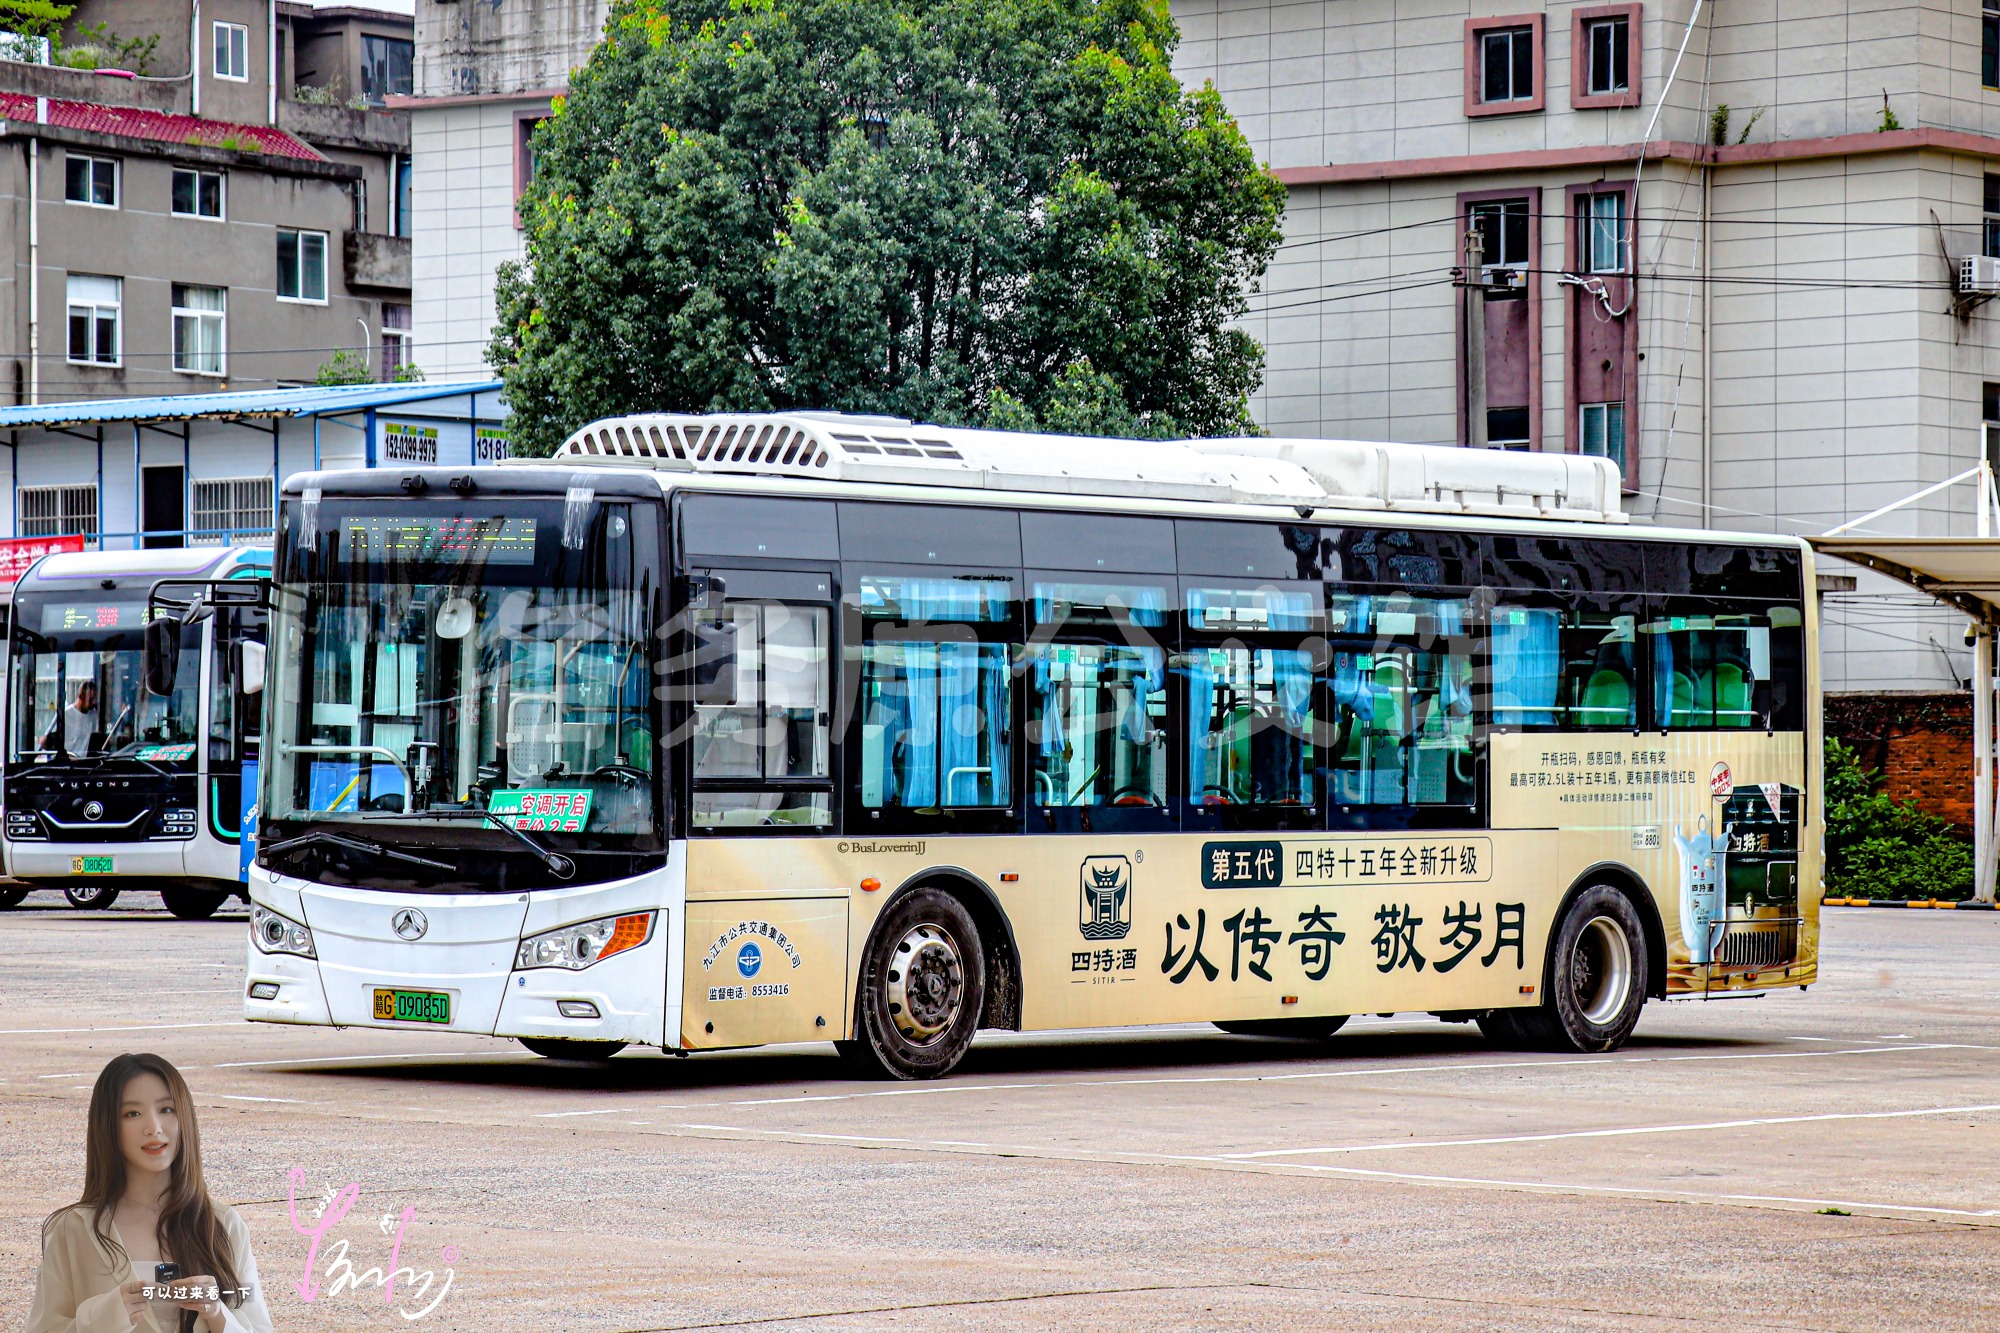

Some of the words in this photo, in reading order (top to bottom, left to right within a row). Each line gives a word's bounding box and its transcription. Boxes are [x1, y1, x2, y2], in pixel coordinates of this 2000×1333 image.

[59, 781, 130, 789] YUTONG
[520, 793, 587, 816] 空调开启
[1211, 848, 1275, 882] 第五代
[1296, 845, 1478, 879] 四特十五年全新升级
[702, 920, 802, 972] 九江市公共交通集团公司
[1161, 904, 1346, 984] 以传奇
[1370, 900, 1525, 974] 敬岁月
[1071, 948, 1137, 973] 四特酒
[1092, 976, 1116, 985] SITIR
